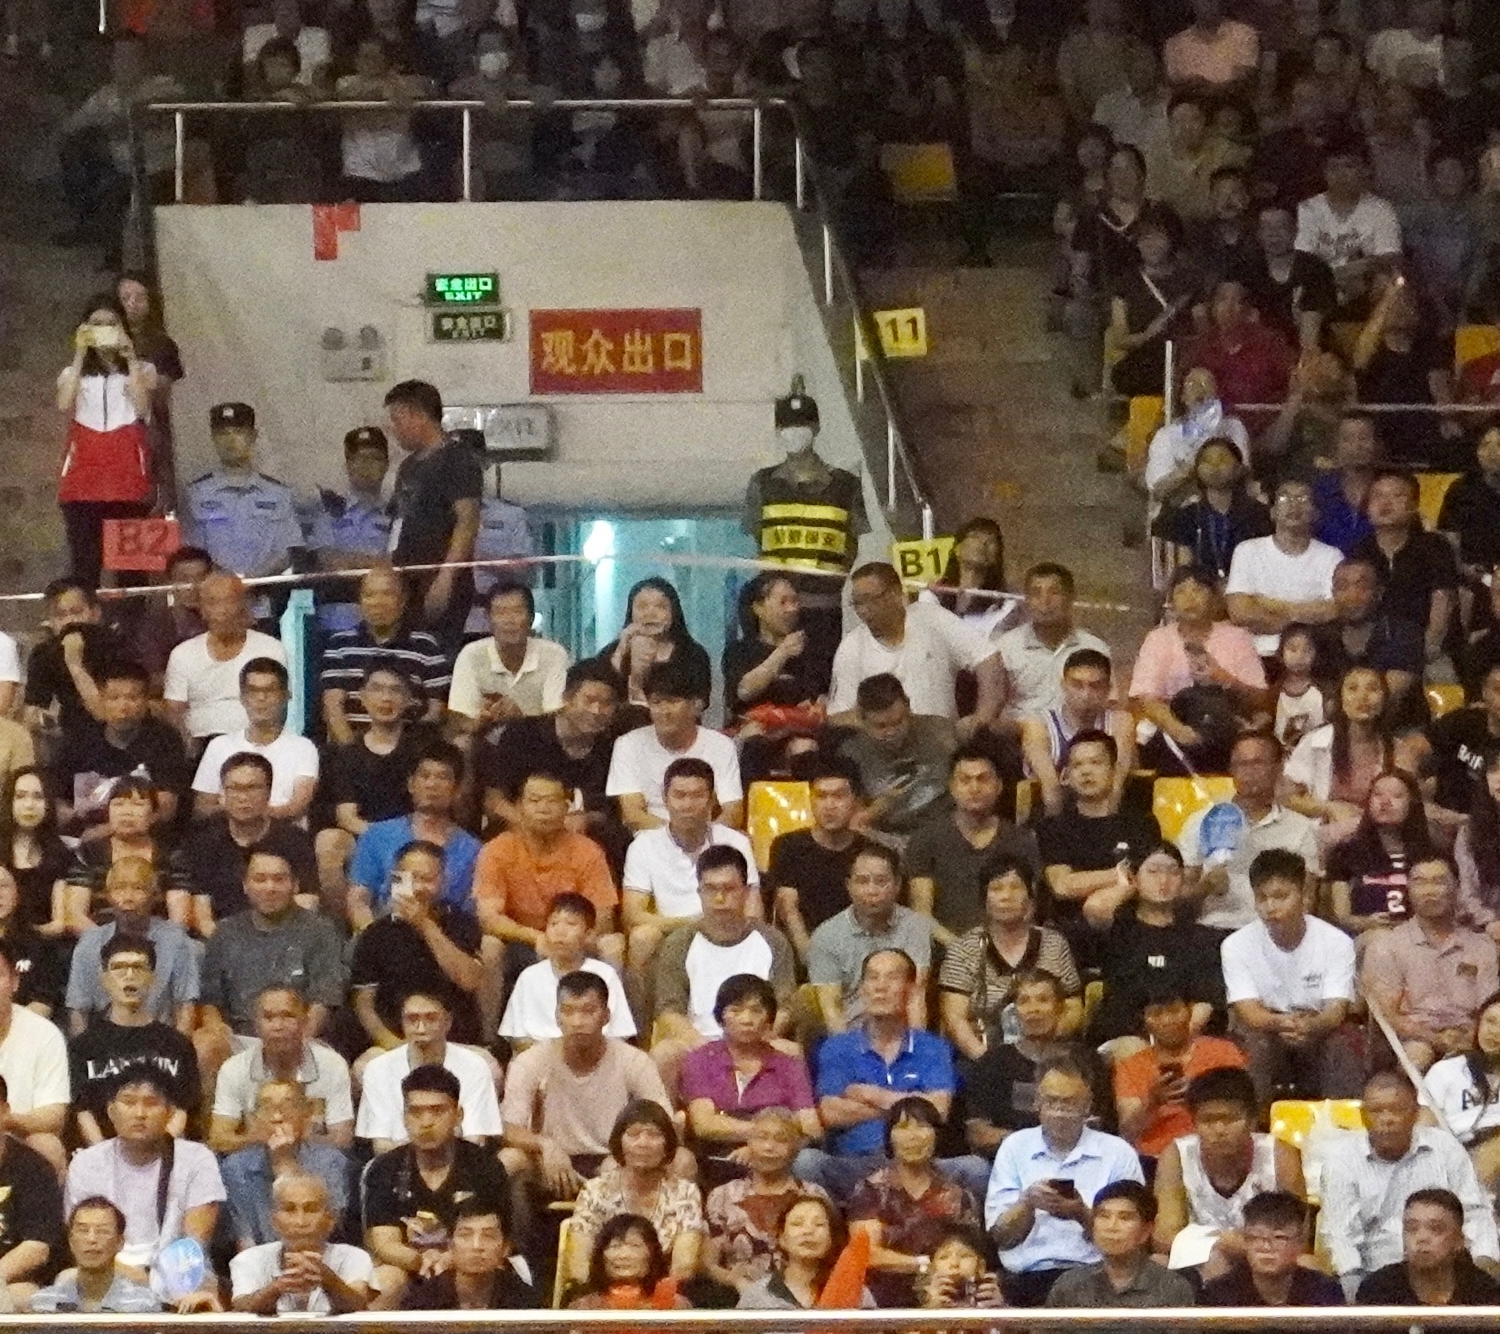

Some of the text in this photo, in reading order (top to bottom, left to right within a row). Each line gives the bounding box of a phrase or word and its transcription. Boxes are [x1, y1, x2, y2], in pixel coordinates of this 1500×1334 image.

[541, 328, 693, 375] 观众出口
[900, 547, 943, 578] B1
